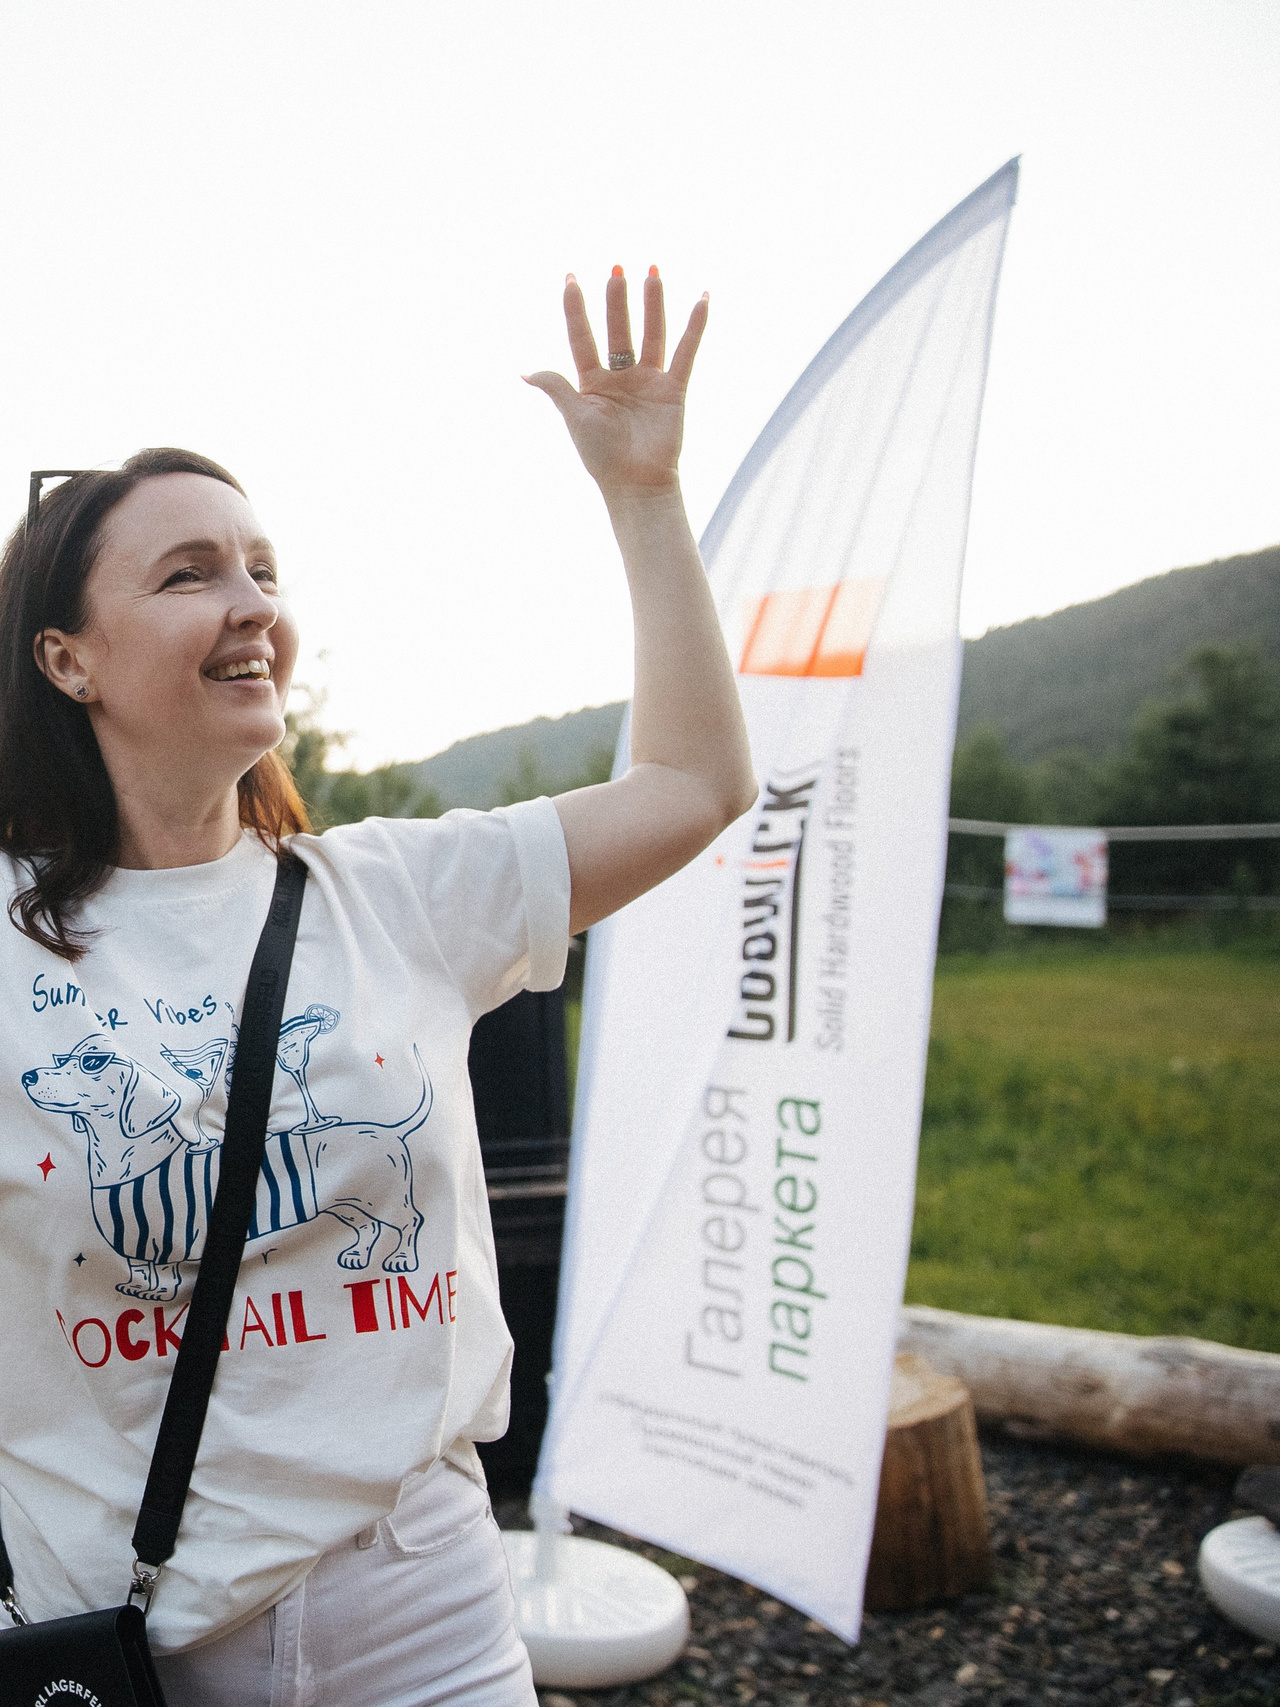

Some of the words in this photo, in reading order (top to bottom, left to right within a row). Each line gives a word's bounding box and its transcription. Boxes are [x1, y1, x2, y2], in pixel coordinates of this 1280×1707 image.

[824, 748, 859, 830] Floors
[822, 841, 854, 978] Hardwood
[143, 994, 217, 1026] Vibes
[816, 986, 847, 1053] Solid
[685, 1085, 762, 1378] Галерея
[770, 1096, 827, 1381] паркета
[55, 1290, 327, 1369] OCKAIL
[342, 1270, 459, 1335] TIME
